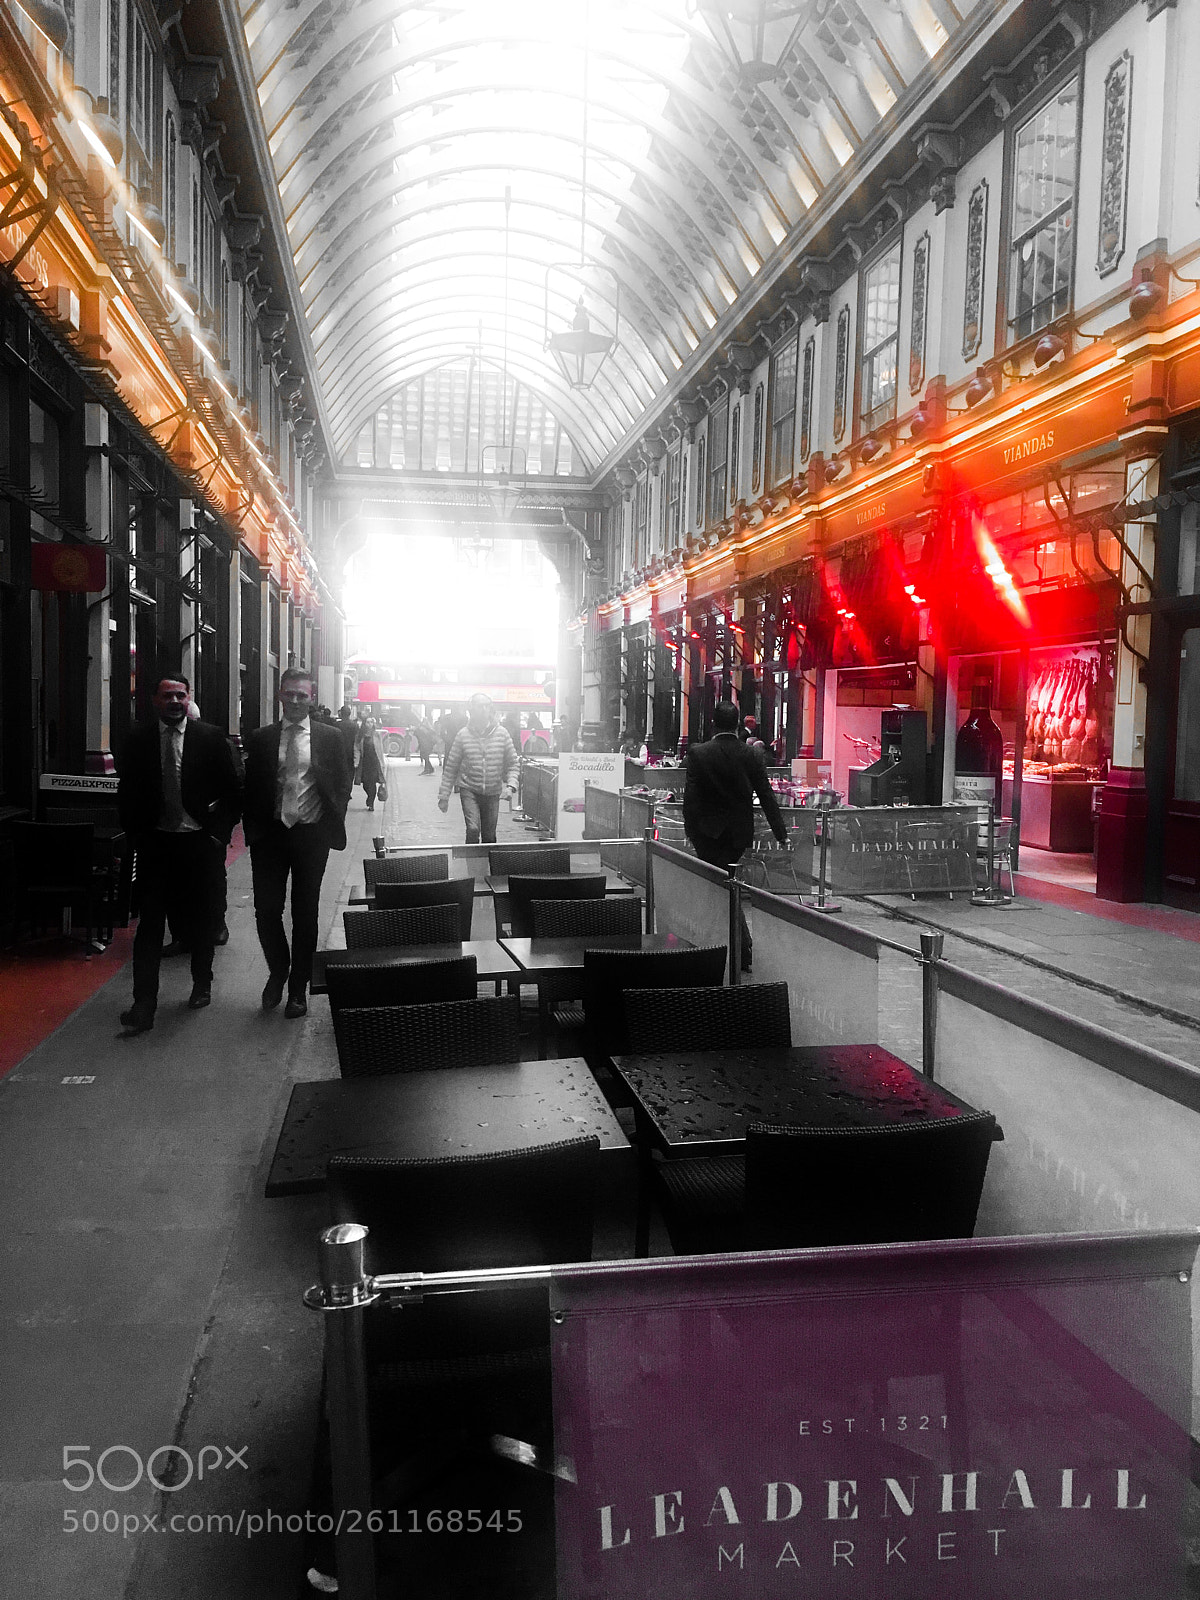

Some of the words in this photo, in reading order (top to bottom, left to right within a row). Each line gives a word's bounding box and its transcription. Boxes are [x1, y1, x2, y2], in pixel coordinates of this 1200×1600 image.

[1003, 430, 1054, 464] VIANDAS
[856, 502, 886, 526] VIANDAS
[569, 761, 614, 771] Bocadillo
[851, 839, 960, 853] LEADENHALL
[596, 1467, 1147, 1551] LEADENHALL
[718, 1529, 1007, 1572] MARKET
